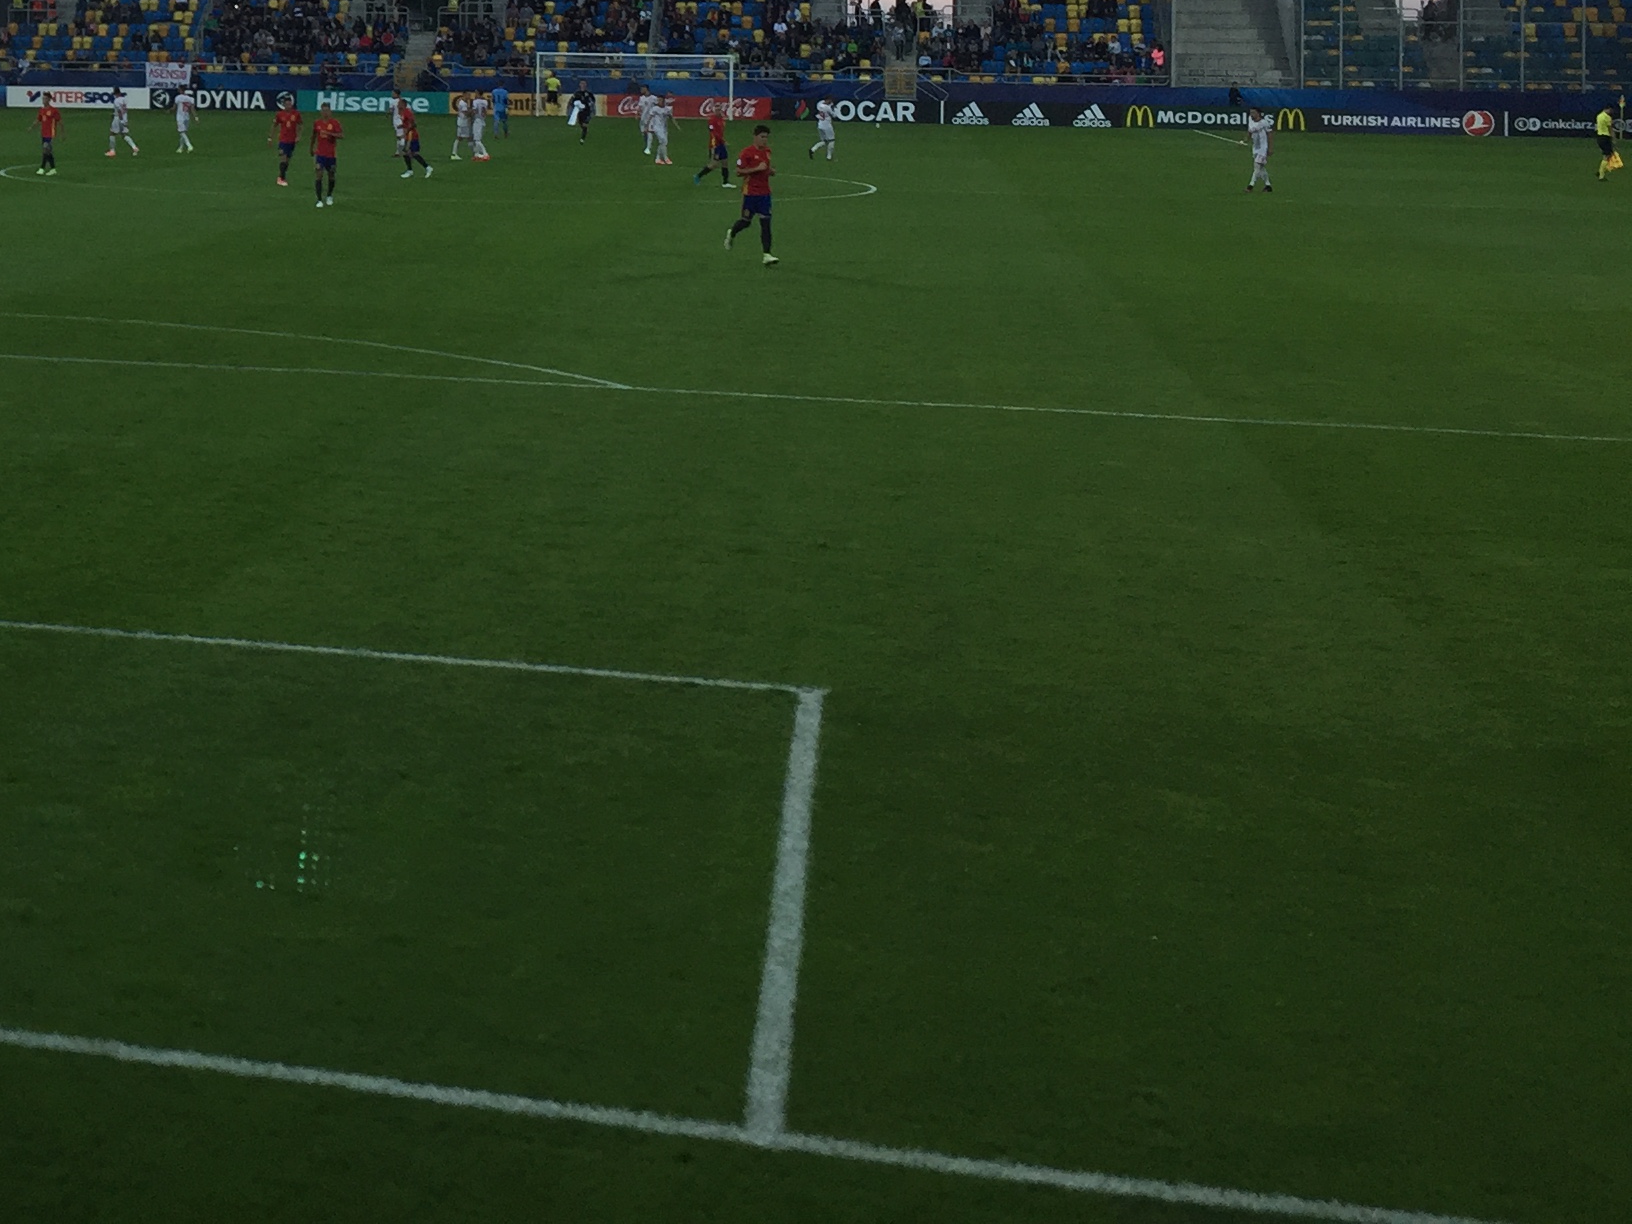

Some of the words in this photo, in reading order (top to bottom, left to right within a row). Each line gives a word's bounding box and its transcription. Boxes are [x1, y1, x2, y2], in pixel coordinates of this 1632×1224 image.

[951, 116, 990, 126] adidas
[1011, 117, 1050, 127] adidas
[1157, 109, 1275, 126] McDonal's
[1321, 114, 1388, 127] TURKISH
[1391, 115, 1461, 128] AIRLINES
[1073, 118, 1112, 128] adidas
